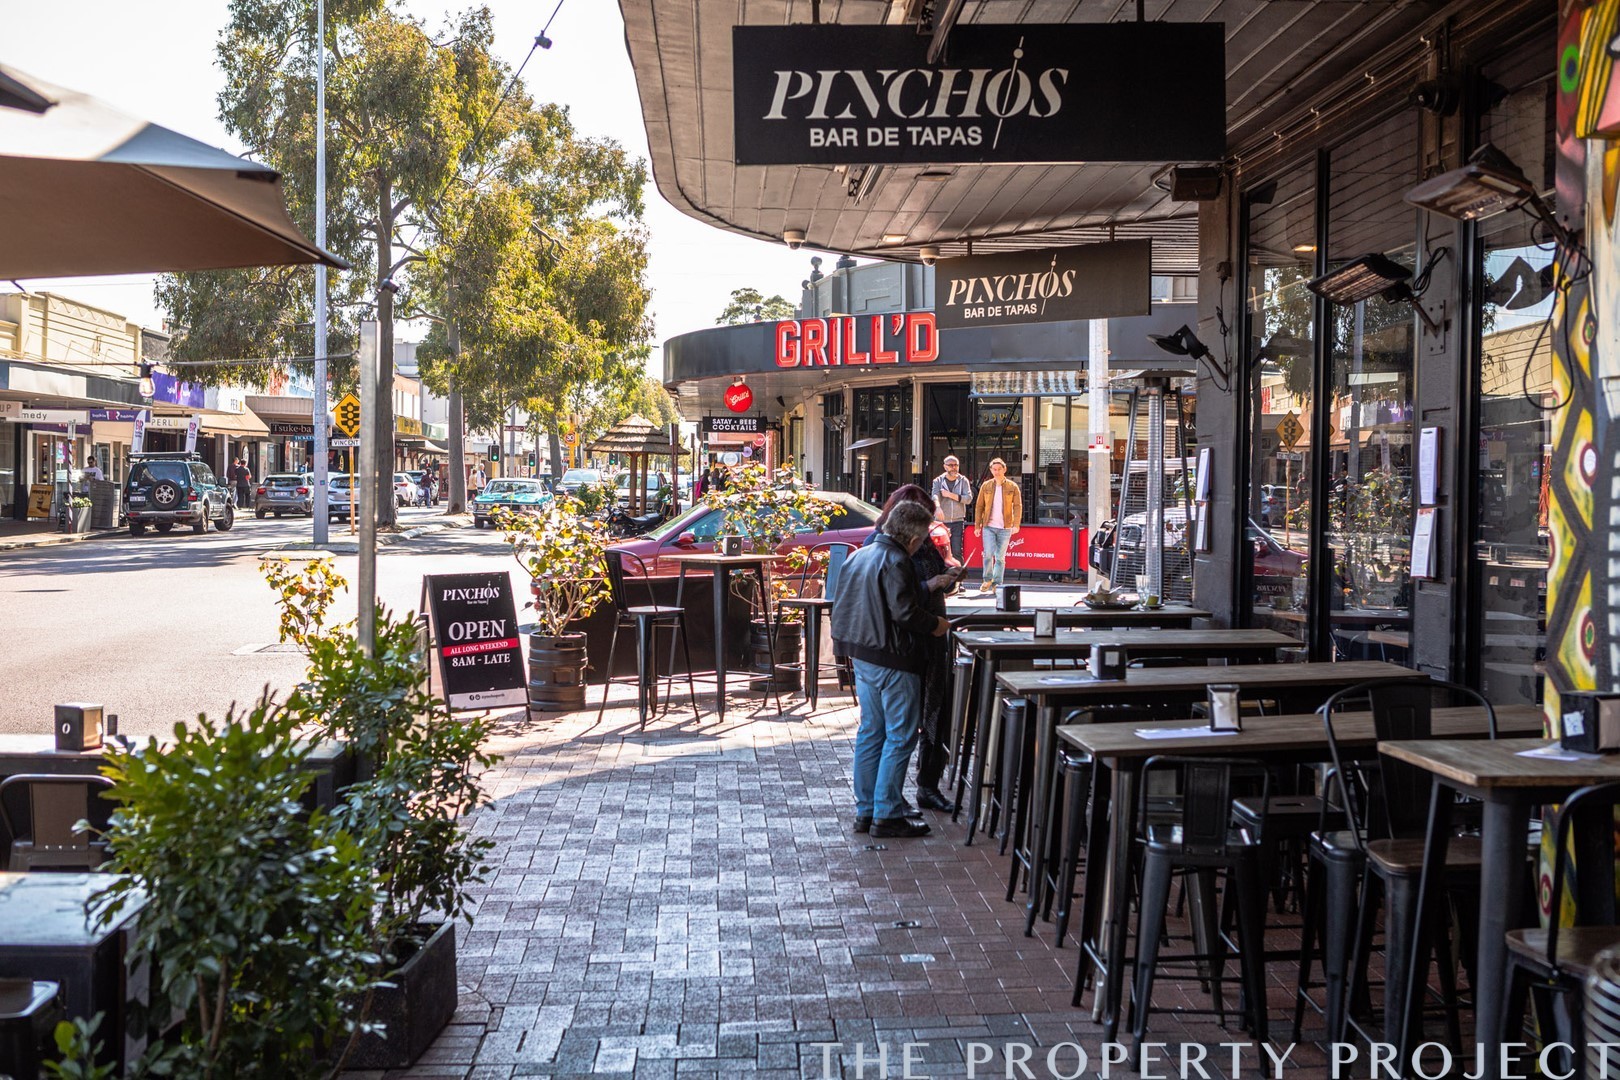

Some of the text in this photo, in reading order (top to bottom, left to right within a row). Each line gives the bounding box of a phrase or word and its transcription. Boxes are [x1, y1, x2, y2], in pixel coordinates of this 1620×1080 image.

[762, 50, 1069, 120] PINCHOS
[809, 126, 982, 147] BAR DE TAPAS
[945, 261, 1076, 306] PINCHOS
[964, 303, 1038, 319] BAR DE TAPAS
[775, 312, 940, 368] GRILL'D
[21, 412, 48, 421] medy
[442, 584, 500, 601] PINCHOS
[448, 619, 507, 641] OPEN
[450, 641, 509, 655] ALL LONG WEEKEND
[452, 655, 476, 667] 8AM
[483, 653, 511, 665] LATE
